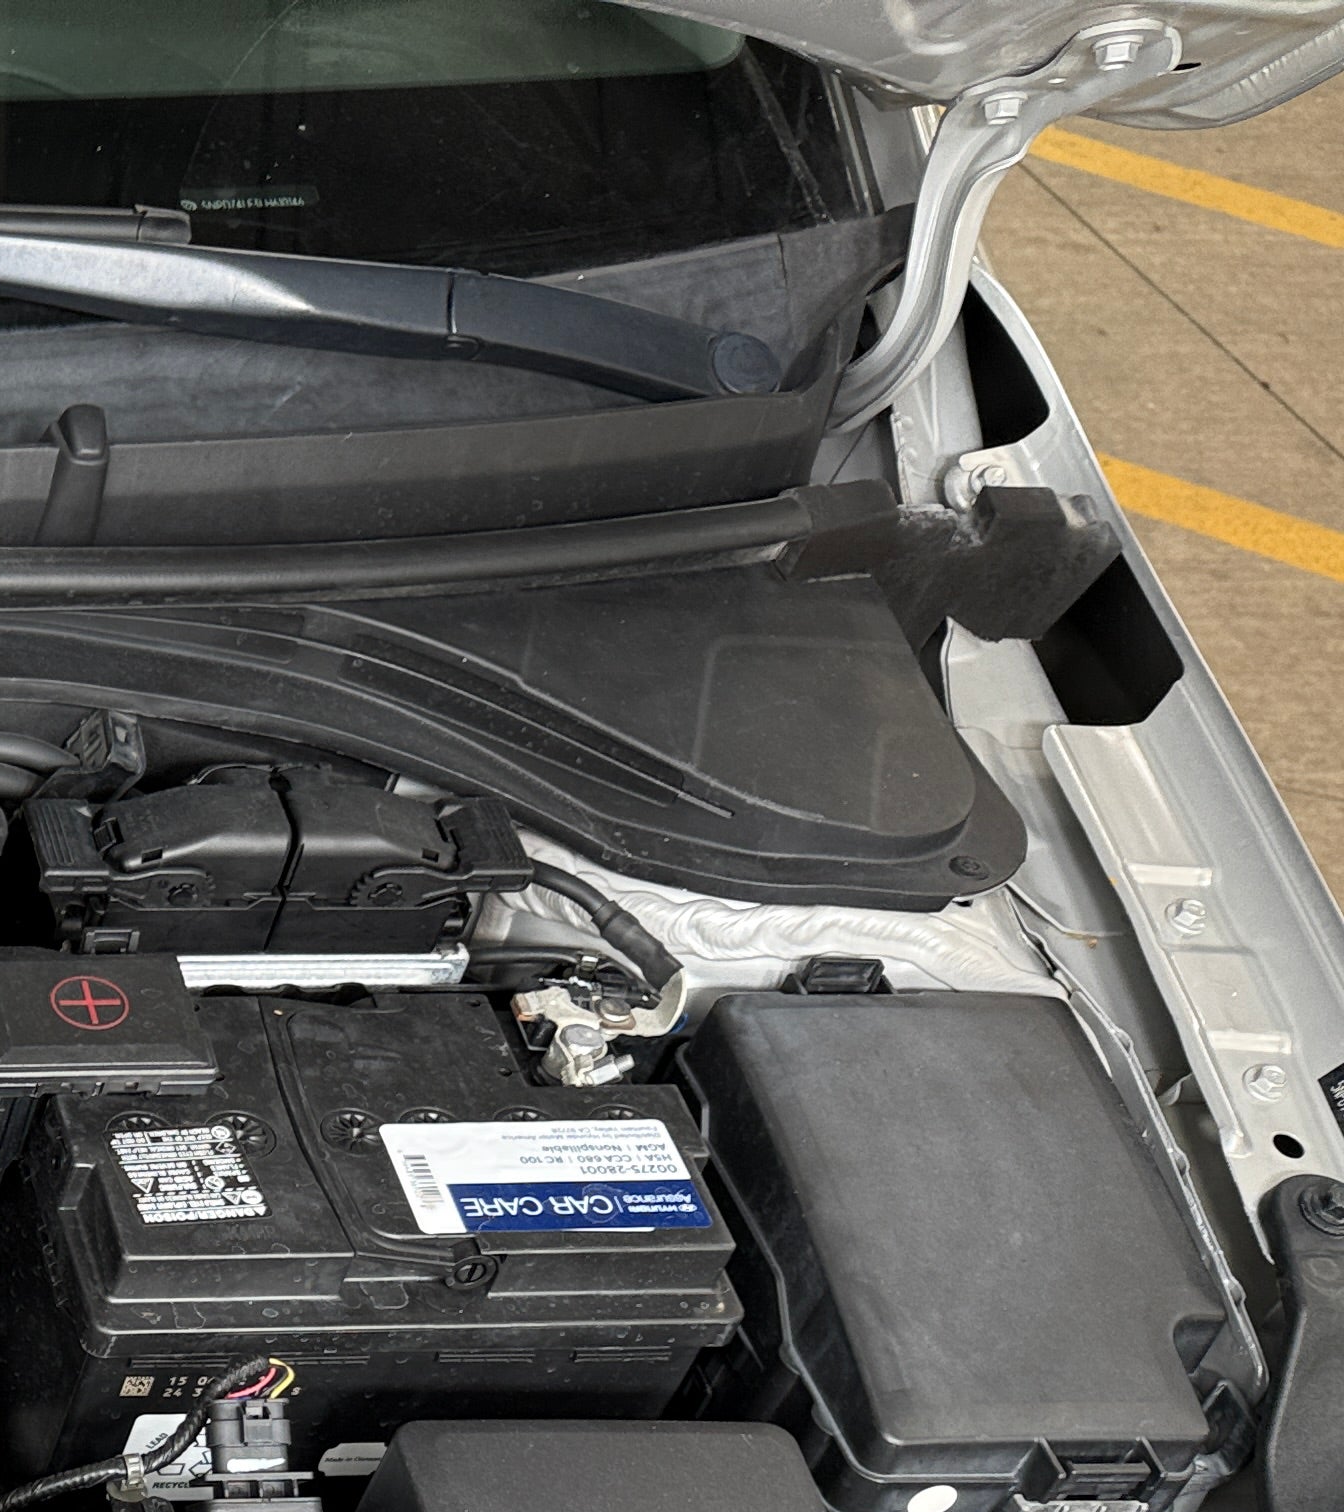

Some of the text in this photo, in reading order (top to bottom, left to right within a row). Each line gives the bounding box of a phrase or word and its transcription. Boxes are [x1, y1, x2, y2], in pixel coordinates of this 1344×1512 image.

[542, 1143, 666, 1154] AGM Nonspillable
[519, 1155, 543, 1165] 100
[544, 1154, 564, 1165] RC
[576, 1154, 602, 1164] 680
[603, 1154, 632, 1164] CCA
[580, 1164, 678, 1176] 00275-28001
[622, 1193, 692, 1204] Assurance
[459, 1194, 613, 1218] CAR CARE
[162, 1388, 183, 1398] 24
[145, 1432, 168, 1449] LEAD
[152, 1480, 192, 1490] RECYCL
